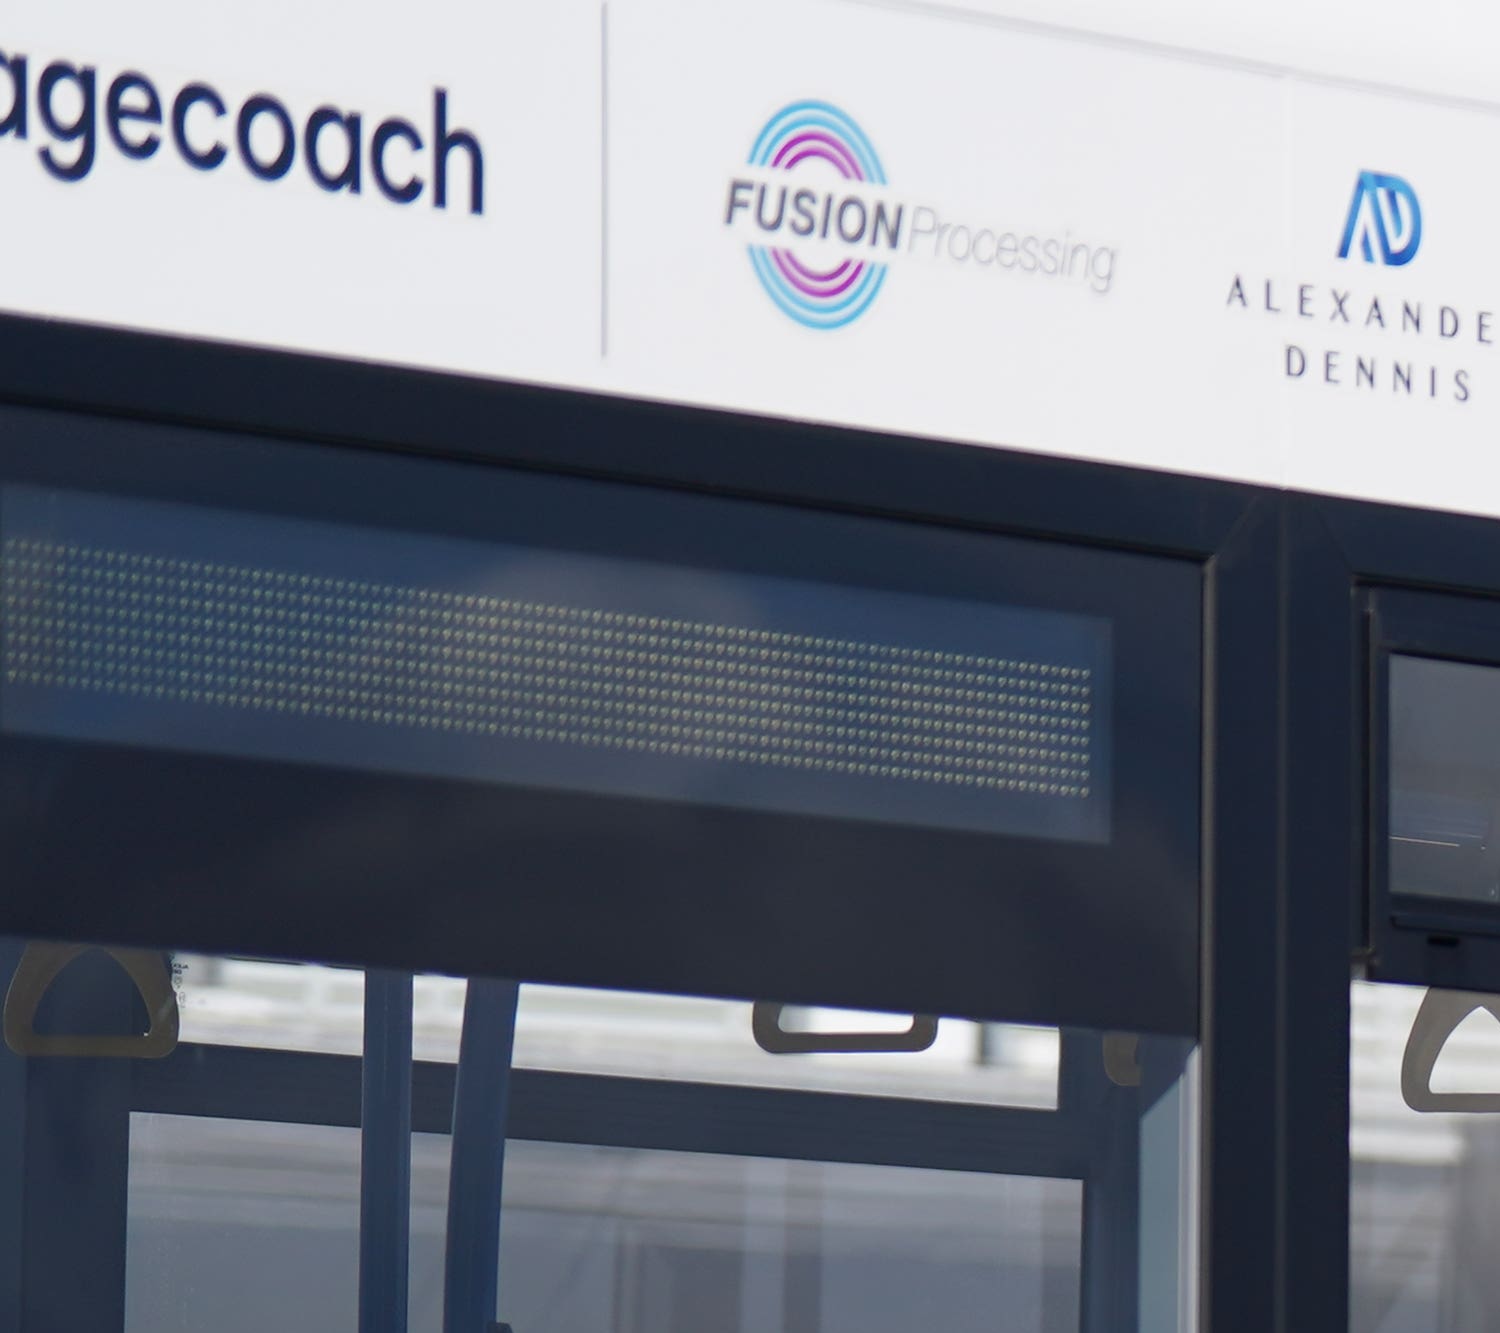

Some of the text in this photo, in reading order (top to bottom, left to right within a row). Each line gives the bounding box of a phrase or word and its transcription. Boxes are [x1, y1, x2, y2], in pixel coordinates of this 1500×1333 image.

[723, 178, 1119, 296] FUSION Processing
[1284, 343, 1472, 404] DENNIS
